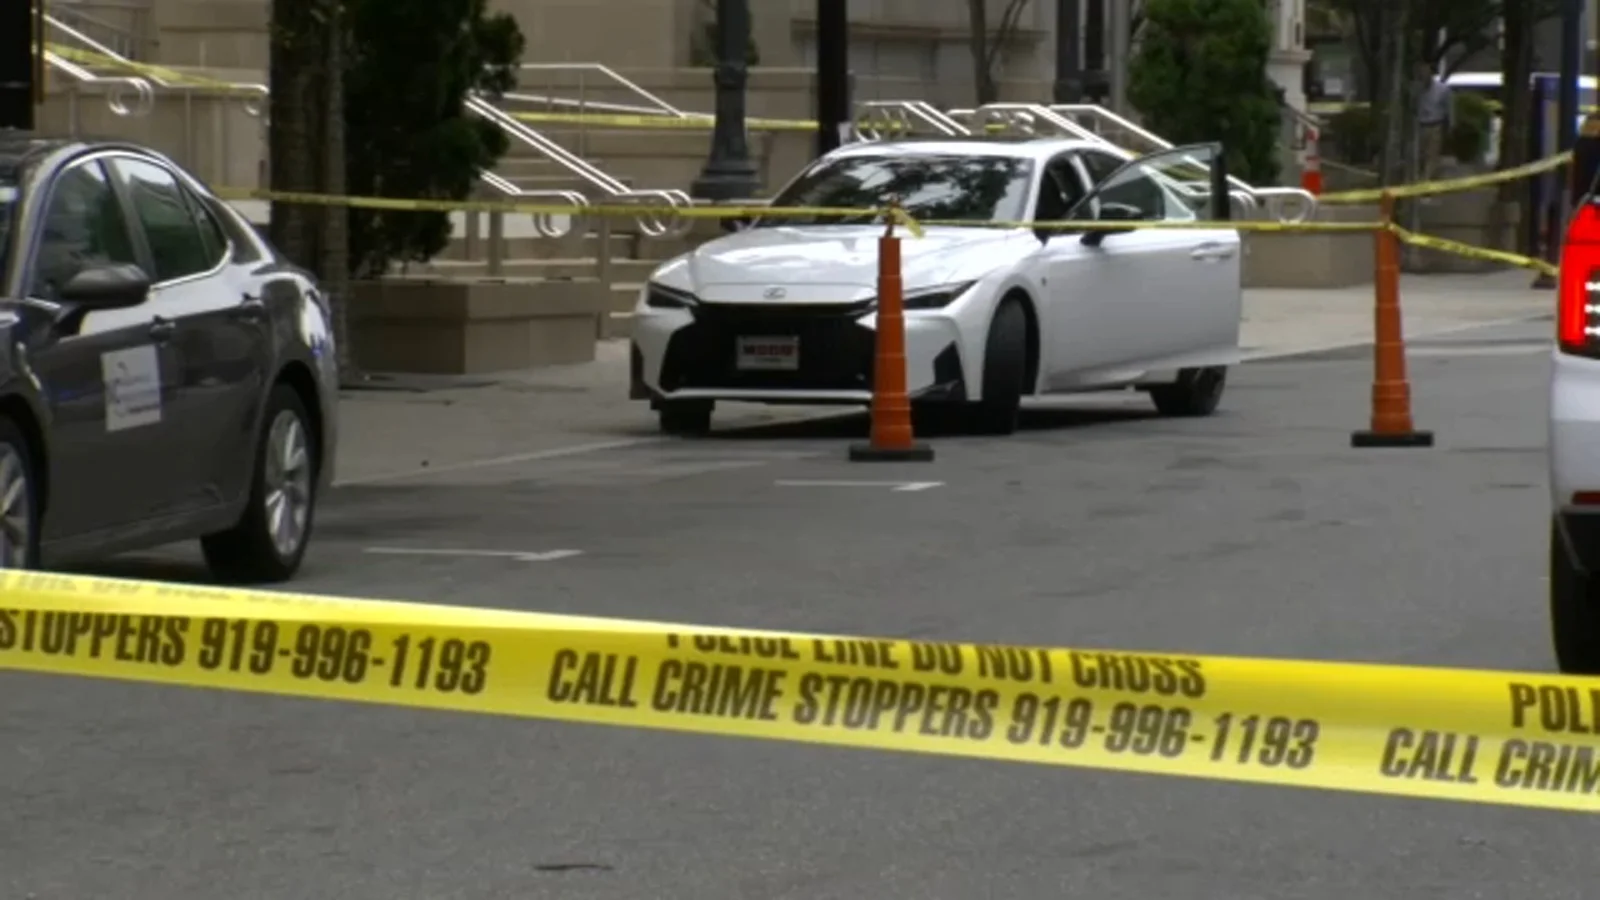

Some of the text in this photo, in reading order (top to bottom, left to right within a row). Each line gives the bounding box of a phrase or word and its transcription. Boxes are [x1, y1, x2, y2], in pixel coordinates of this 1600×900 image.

[0, 609, 491, 694] STOPPERS 919-996-1193
[978, 646, 1052, 683] NOT
[1070, 650, 1206, 699] CROSS
[546, 649, 1319, 769] CALL CRIME STOPPERS 919-996-1193
[1380, 727, 1480, 784] CALL
